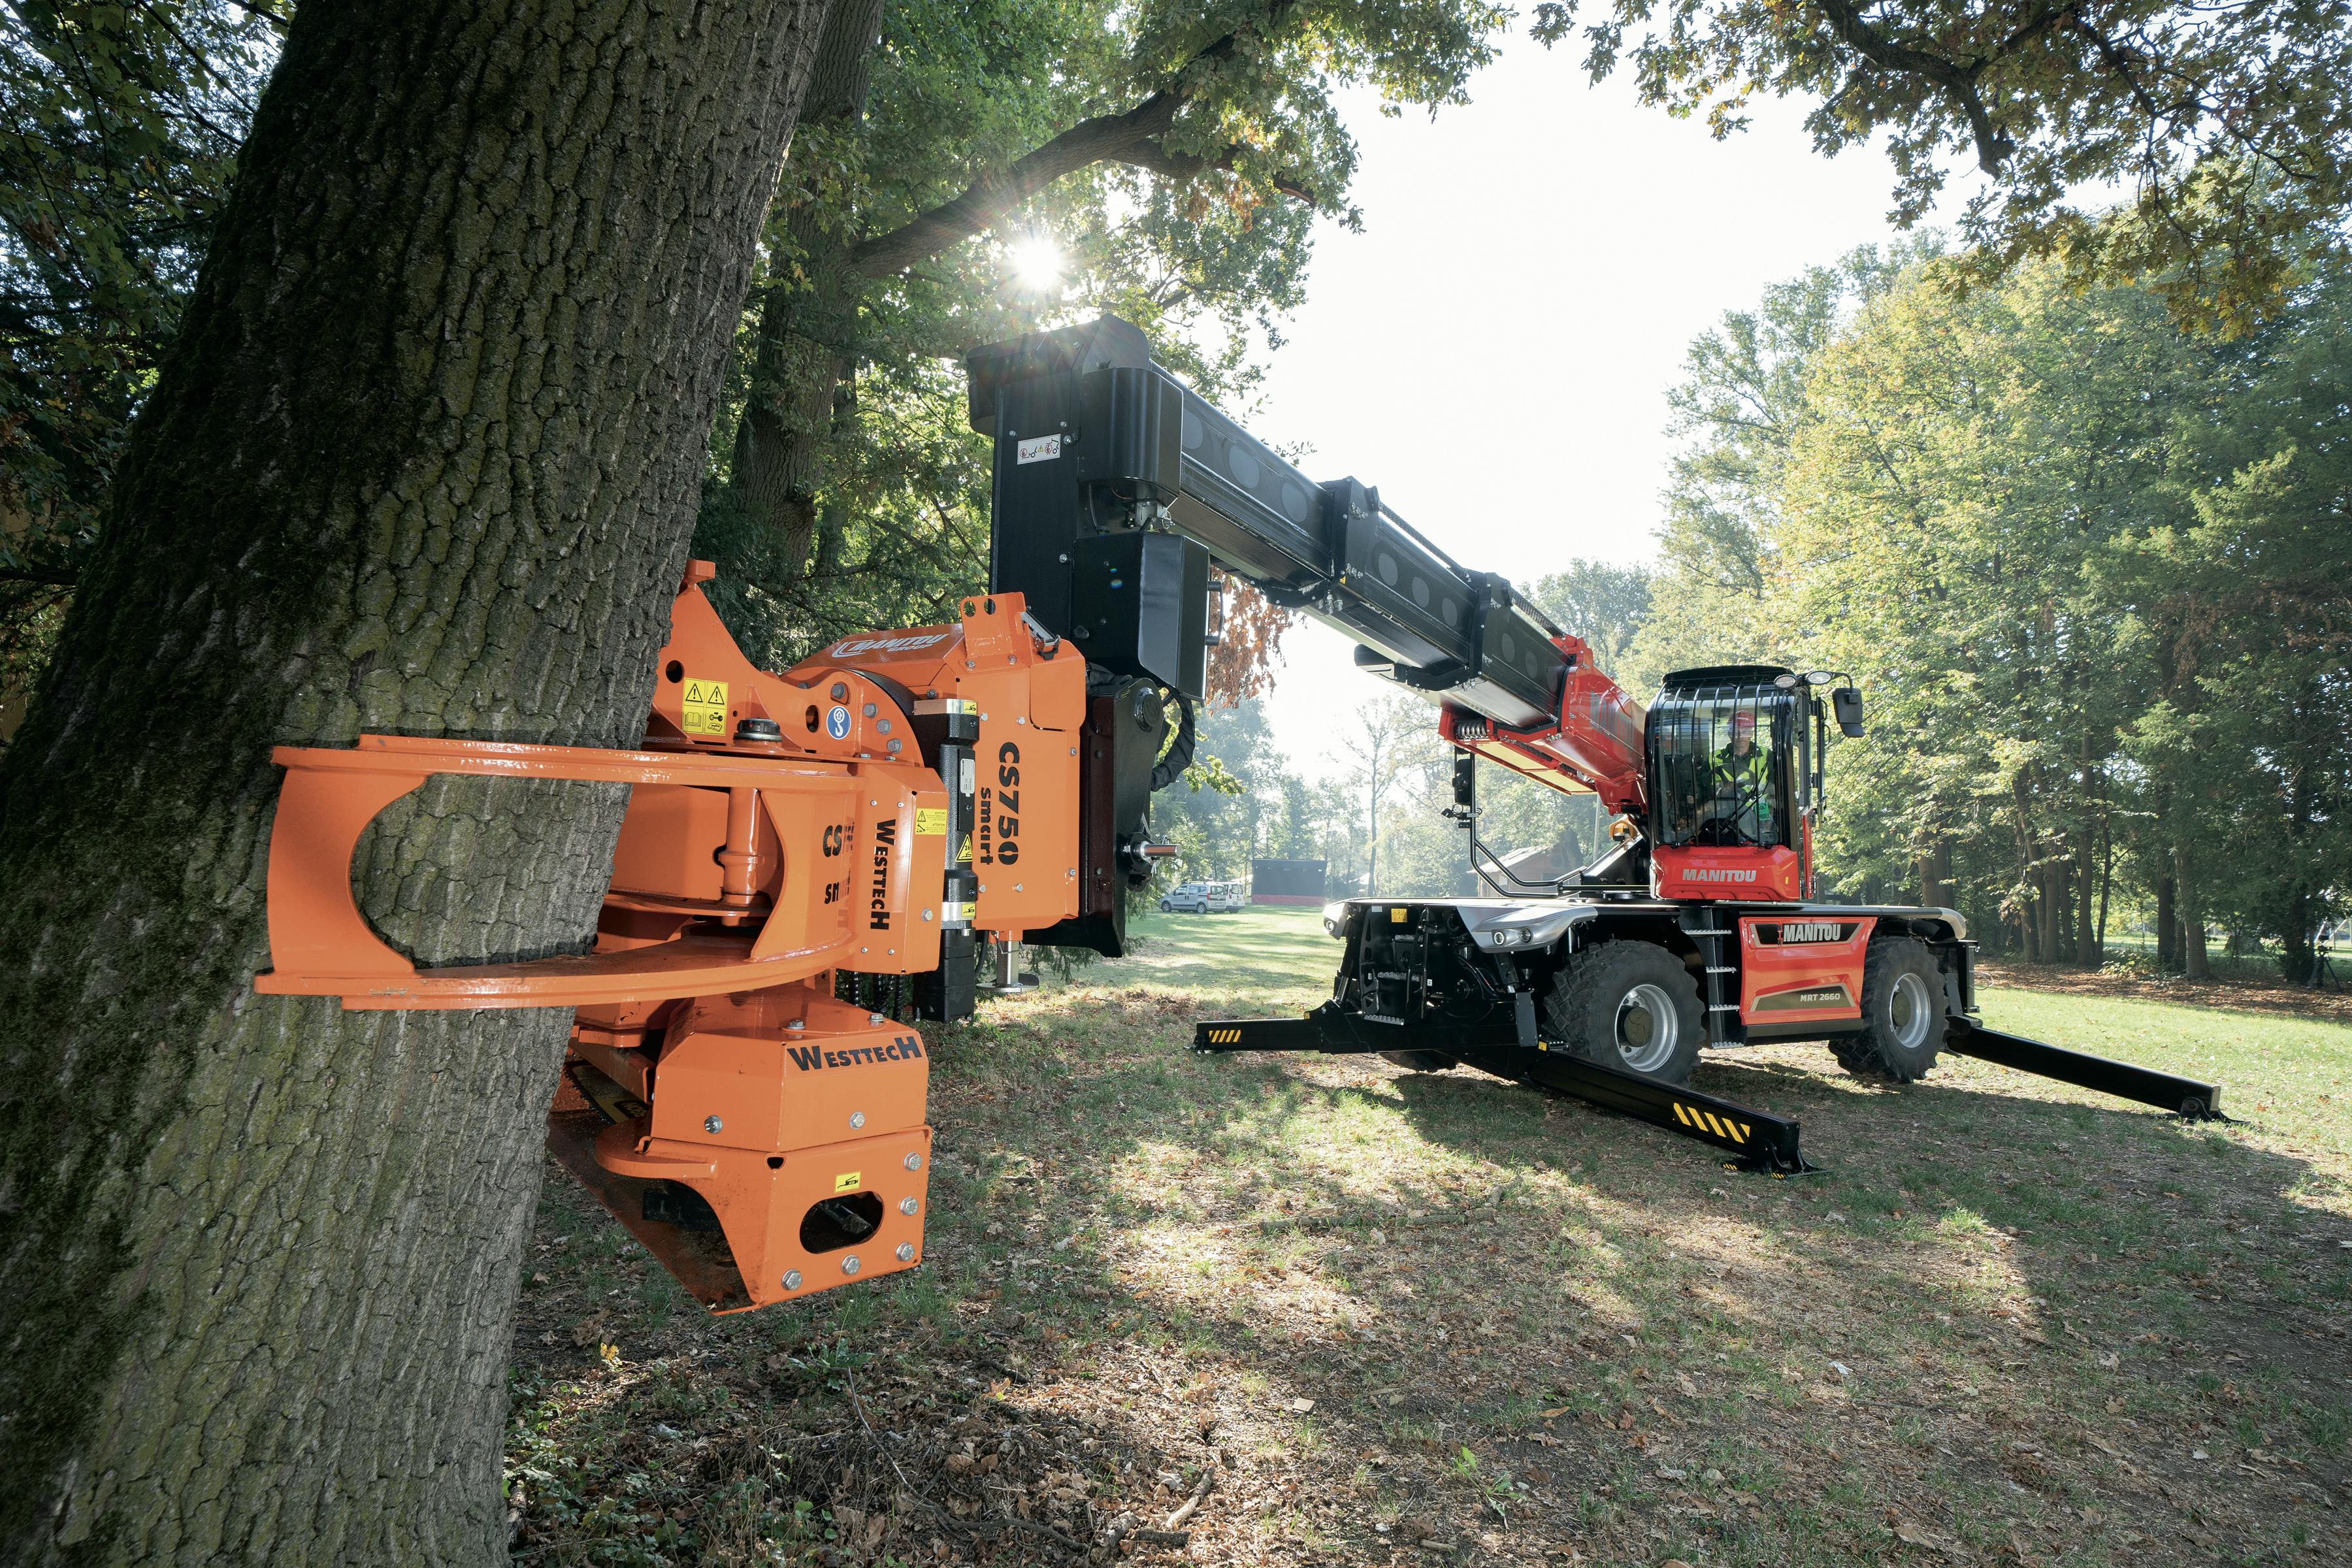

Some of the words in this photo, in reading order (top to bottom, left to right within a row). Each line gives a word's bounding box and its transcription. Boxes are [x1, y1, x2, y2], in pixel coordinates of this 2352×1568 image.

[839, 633, 950, 655] MANITOU
[887, 644, 933, 652] GROUP
[998, 742, 1020, 865] CS750
[980, 787, 993, 865] smart
[1682, 868, 1757, 882] MANITOU
[1783, 924, 1841, 942] MANITOU
[1800, 994, 1818, 1002] MRT
